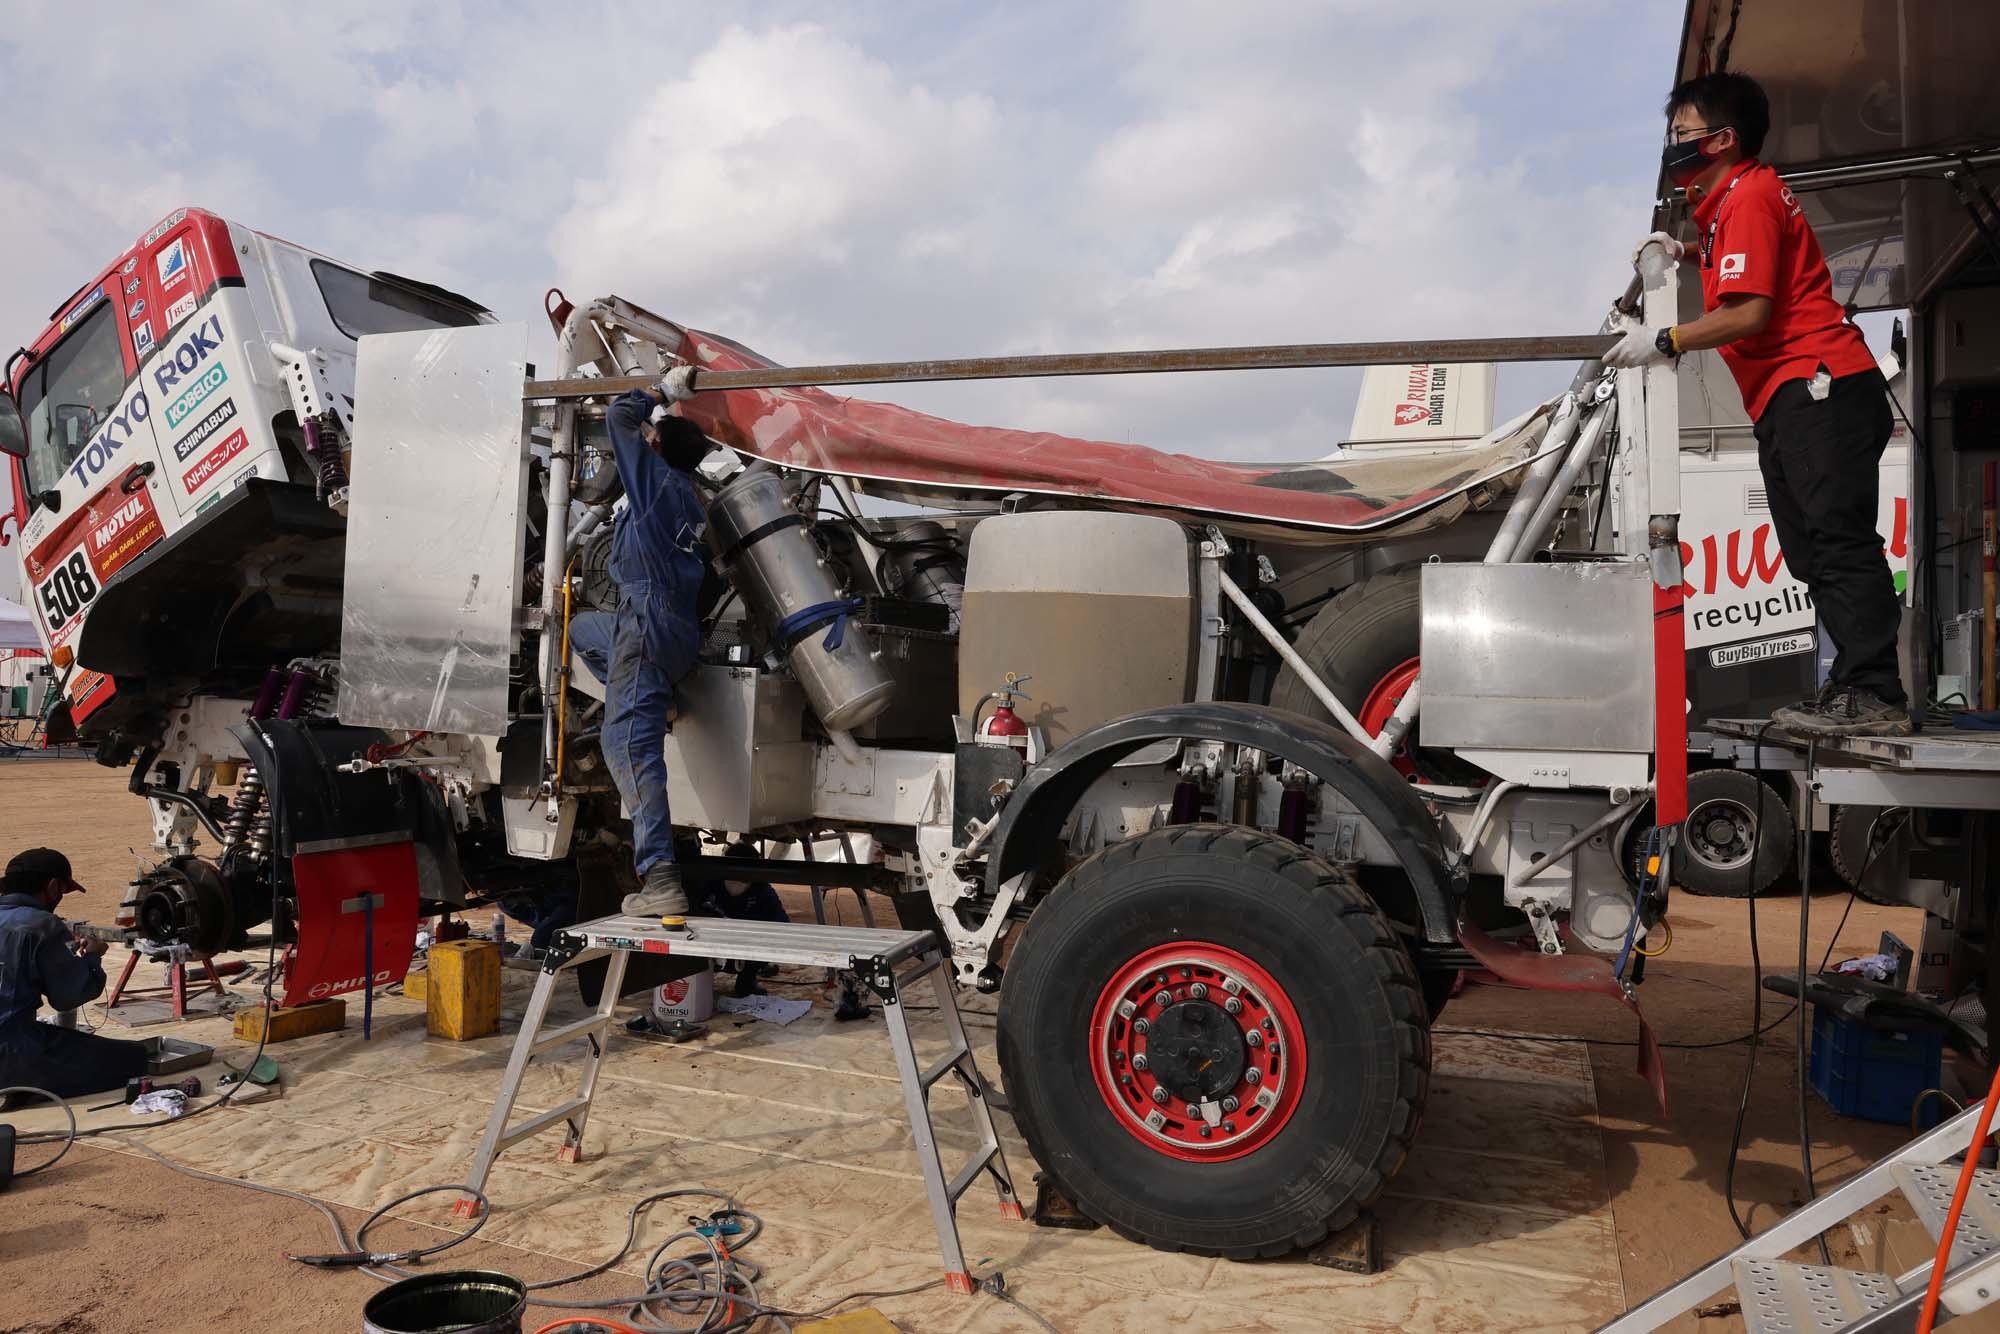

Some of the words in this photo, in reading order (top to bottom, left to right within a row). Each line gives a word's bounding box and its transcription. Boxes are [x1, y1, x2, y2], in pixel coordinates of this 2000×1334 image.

[71, 391, 150, 489] TOKYO
[153, 314, 225, 397] ROKI
[168, 367, 224, 425] KOBELCO
[1431, 367, 1447, 392] TEAM
[179, 402, 234, 458] SHIMABUN
[1427, 394, 1445, 426] DAKAR
[95, 496, 145, 550] MOTUL
[40, 551, 97, 631] 508
